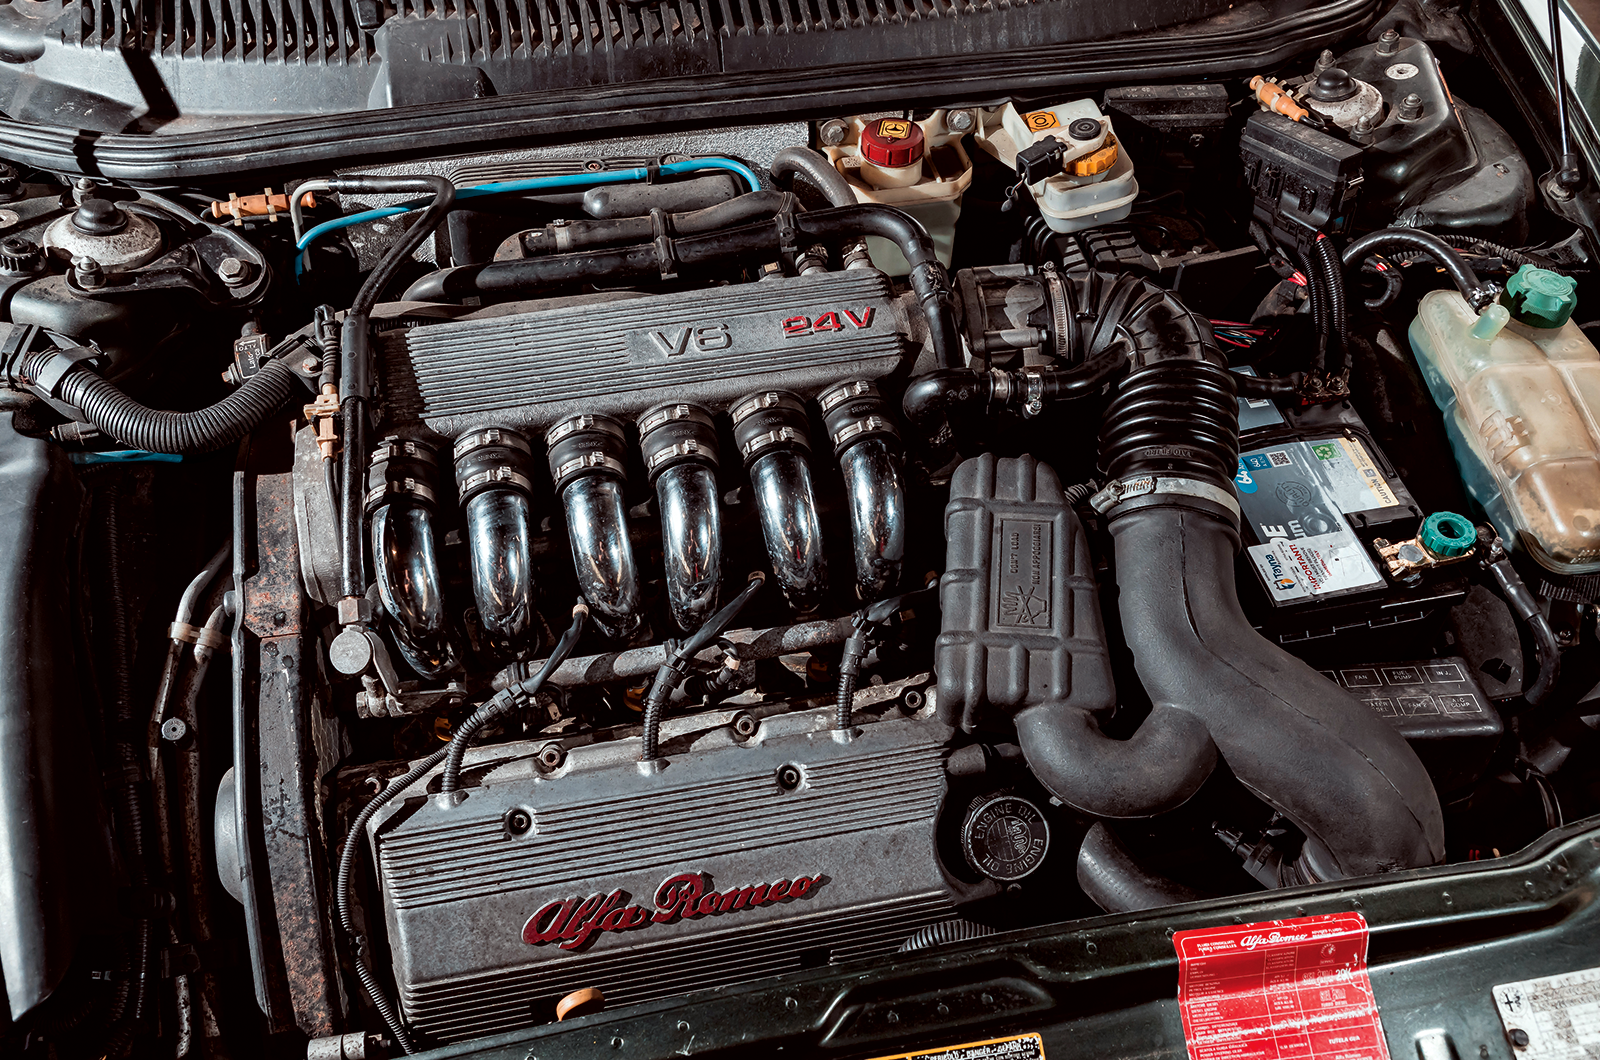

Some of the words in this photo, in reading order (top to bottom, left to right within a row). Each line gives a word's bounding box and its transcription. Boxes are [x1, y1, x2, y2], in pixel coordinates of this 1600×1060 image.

[649, 323, 732, 358] V6
[781, 307, 876, 339] 24V
[1371, 478, 1392, 505] CAUTION
[1265, 554, 1284, 579] Tayna
[1289, 543, 1322, 590] IMPORTANT!
[974, 802, 1012, 840] ENGINE
[1018, 805, 1036, 825] OIL
[982, 852, 1000, 872] OIL
[1006, 838, 1044, 874] ENGINE
[521, 888, 647, 950] Alfa
[650, 870, 824, 923] Romeo
[1240, 935, 1269, 951] Alfa
[1268, 931, 1307, 944] Romeo
